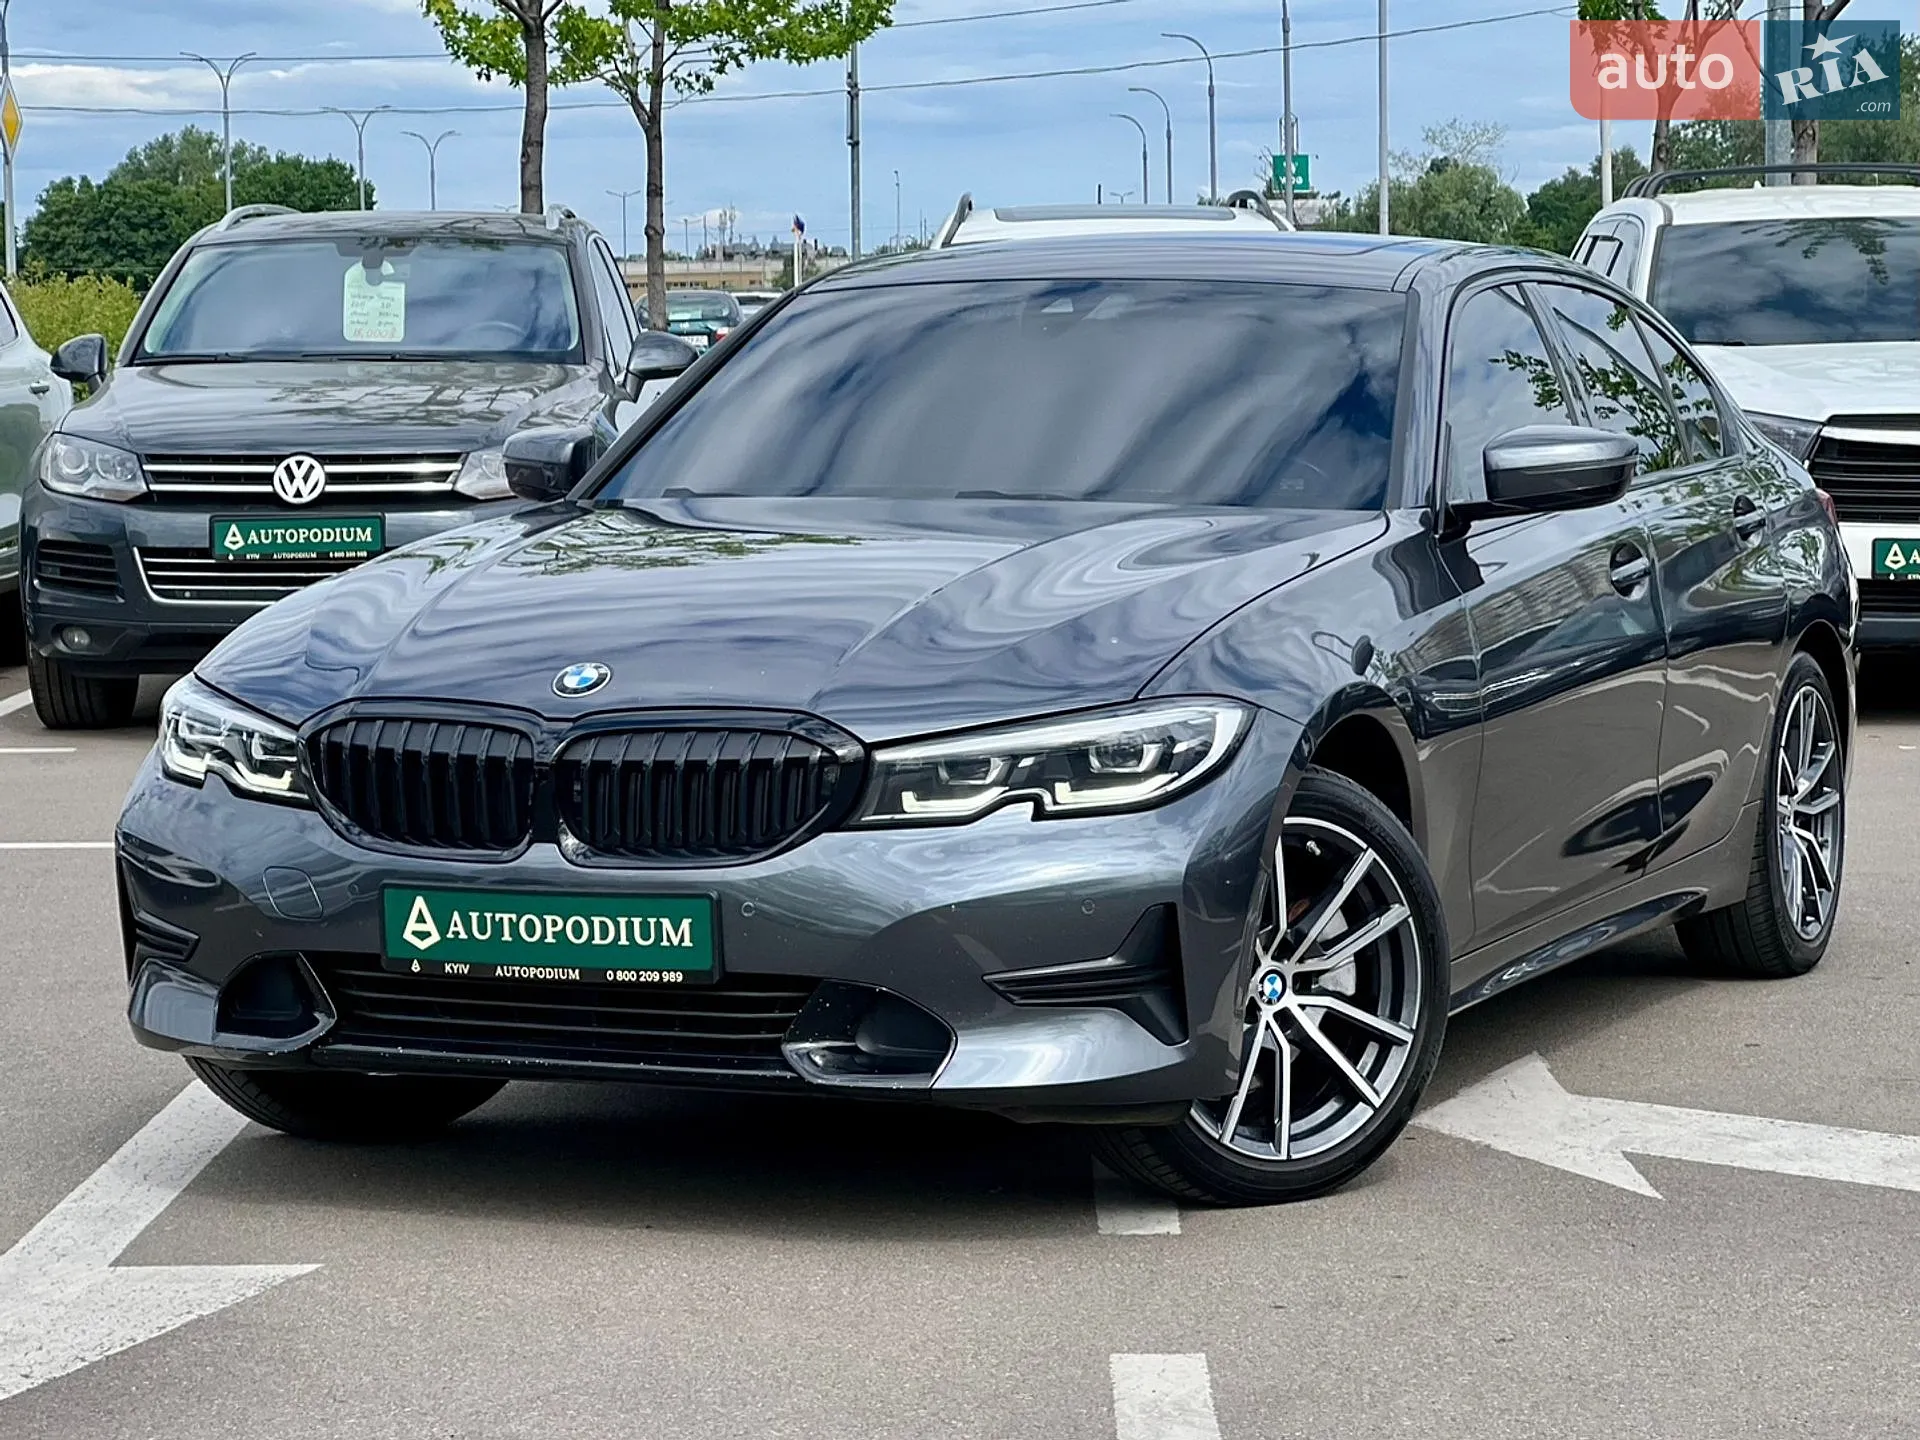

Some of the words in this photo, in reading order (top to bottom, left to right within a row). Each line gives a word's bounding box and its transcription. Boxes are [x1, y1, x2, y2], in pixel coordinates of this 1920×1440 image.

[247, 527, 373, 545] AUTOPODIUM
[445, 910, 693, 948] AUTOPODIUM
[444, 963, 470, 975] KYIV
[494, 965, 580, 981] AUTOPODIUM
[606, 970, 614, 981] 0
[616, 970, 637, 982] 800
[638, 971, 660, 982] 209
[662, 971, 683, 983] 989
